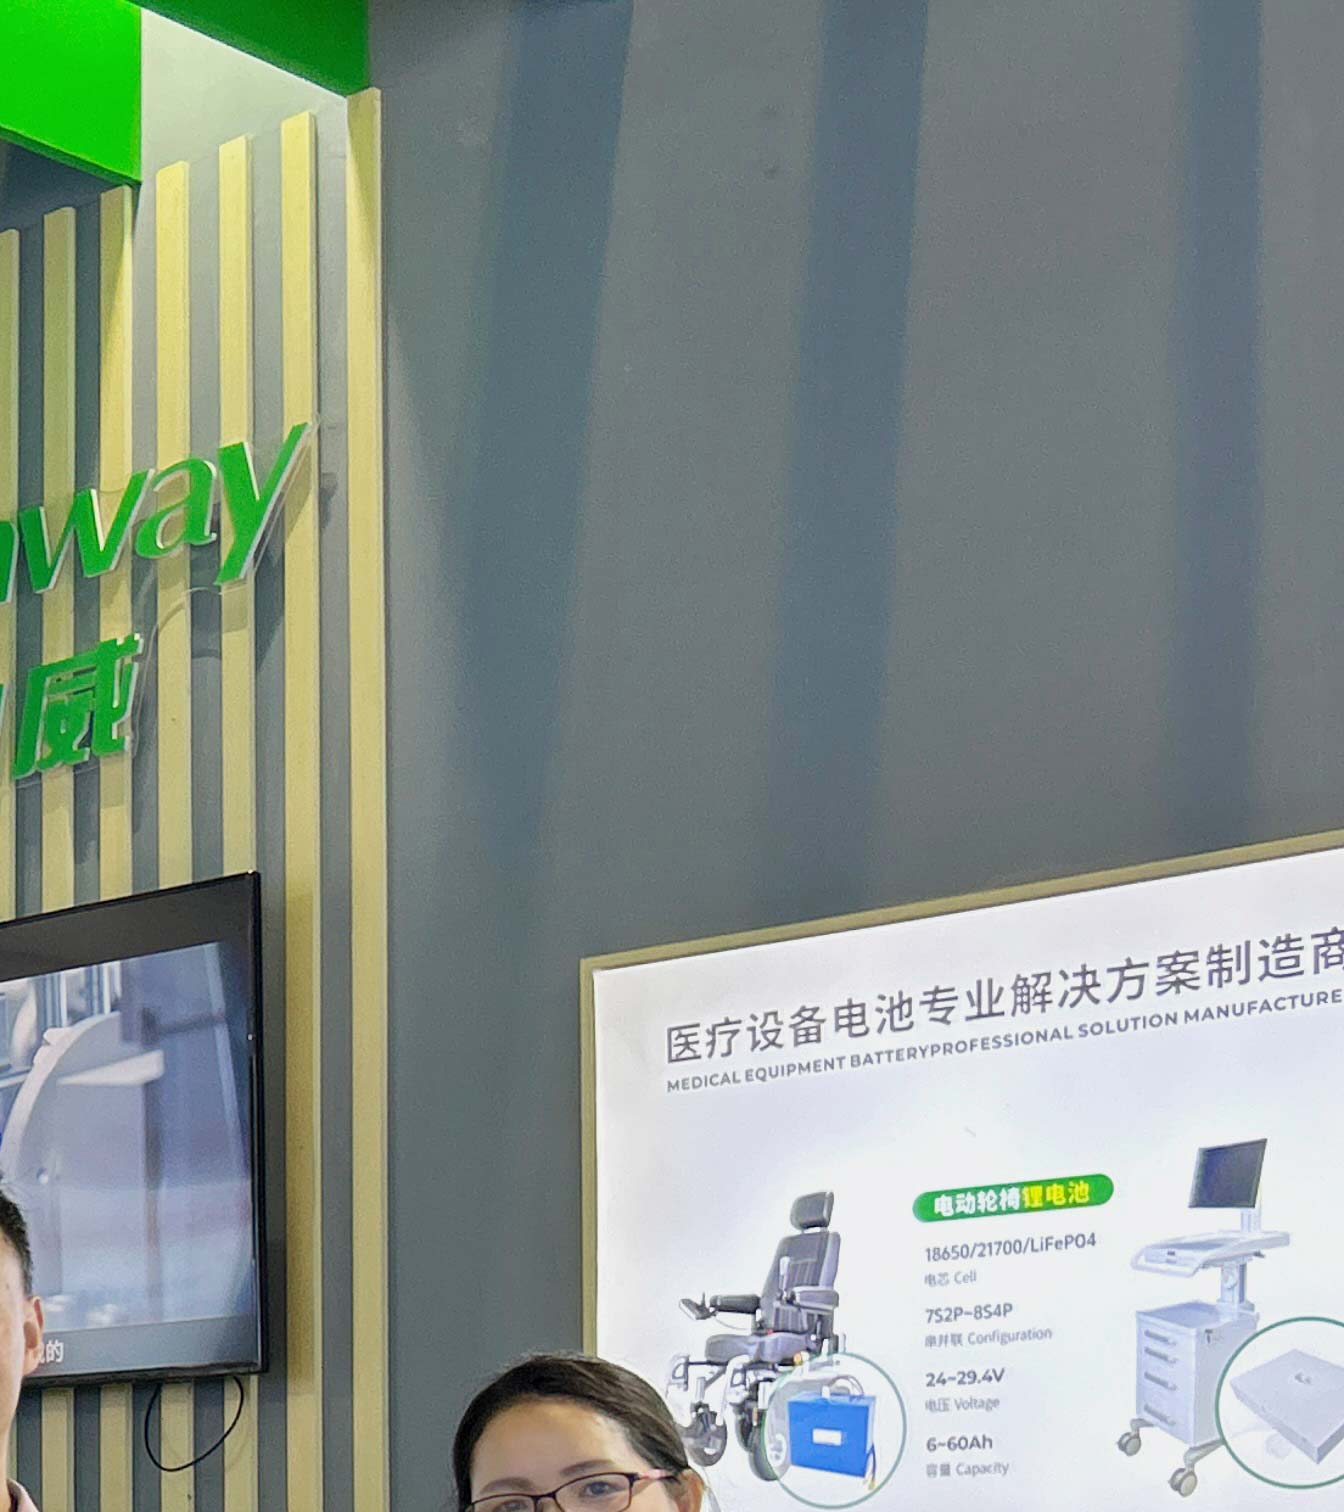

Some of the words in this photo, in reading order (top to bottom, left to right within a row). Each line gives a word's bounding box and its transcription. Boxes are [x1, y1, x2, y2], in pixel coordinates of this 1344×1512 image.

[666, 926, 1344, 1065] 医疗设备电池专业解决方案制造商
[666, 1071, 742, 1093] MEDICAL
[744, 1055, 846, 1083] EQUIPMENT
[850, 1026, 1074, 1069] BATTERYPROFESSIONAL
[1078, 1011, 1179, 1039] SOLUTION
[934, 1180, 1090, 1217] 电动轮椅锂电池
[925, 1231, 1097, 1262] 18650/21700/LiFePO4
[954, 1269, 977, 1285] Cell
[967, 1328, 1053, 1346] Configuration
[954, 1396, 1001, 1412] Voltage
[956, 1462, 1010, 1477] Capacity
